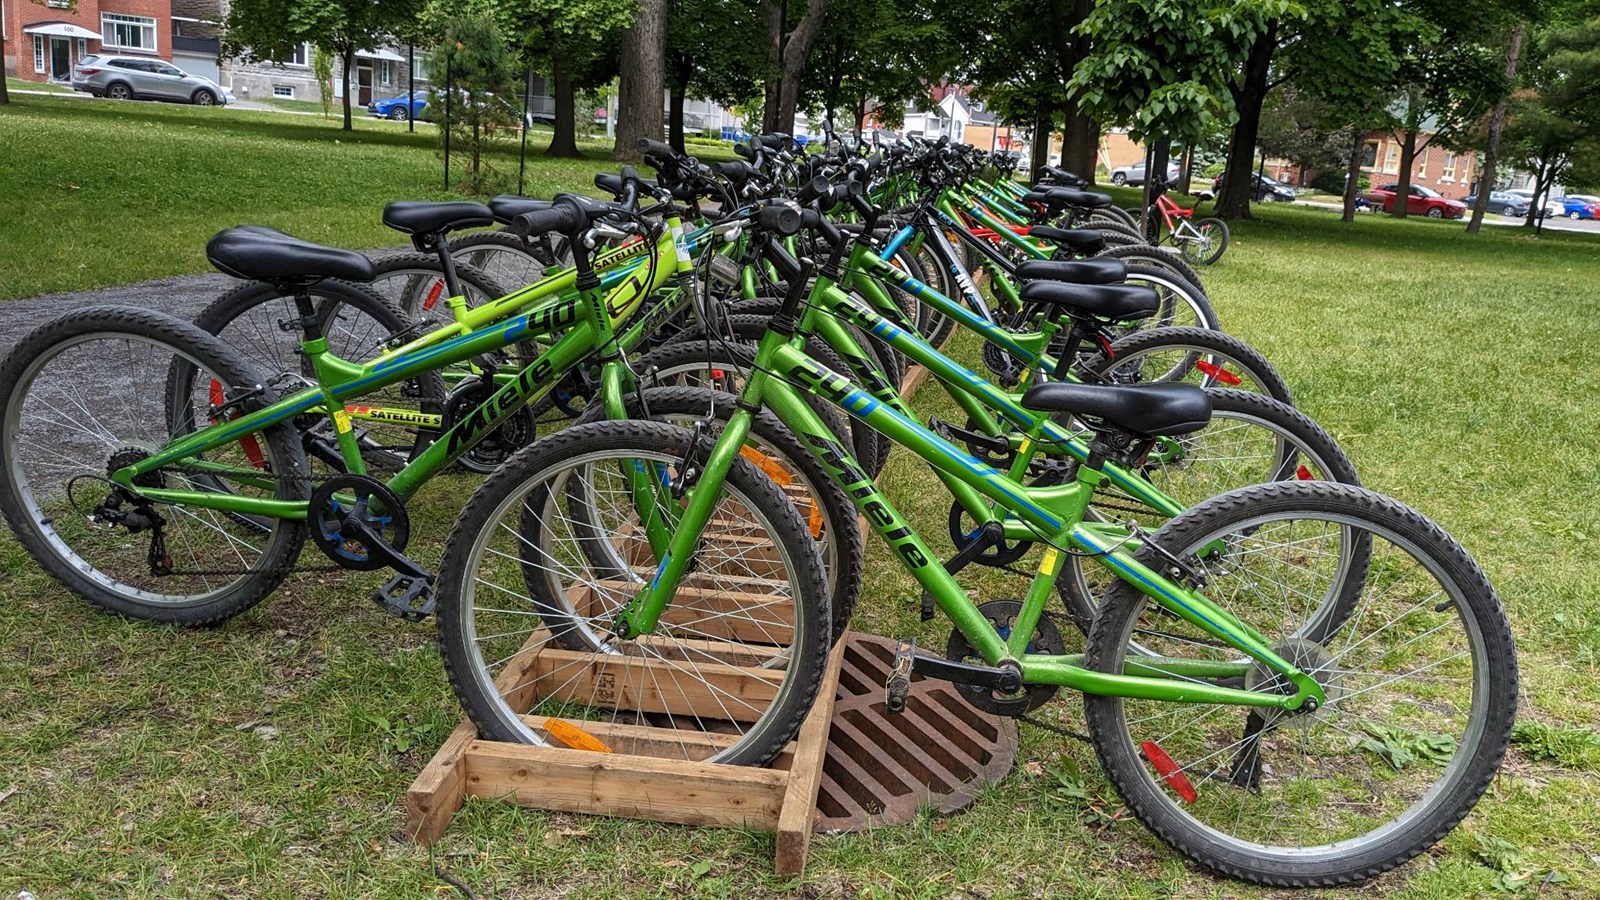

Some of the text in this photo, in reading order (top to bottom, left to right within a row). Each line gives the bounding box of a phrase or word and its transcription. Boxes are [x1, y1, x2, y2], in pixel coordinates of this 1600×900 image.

[868, 259, 926, 295] 240
[503, 299, 576, 343] 240
[833, 296, 903, 342] 240
[446, 357, 553, 456] Miele
[786, 357, 882, 418] 240
[370, 410, 431, 425] SATELLITE
[801, 430, 929, 570] Miele
